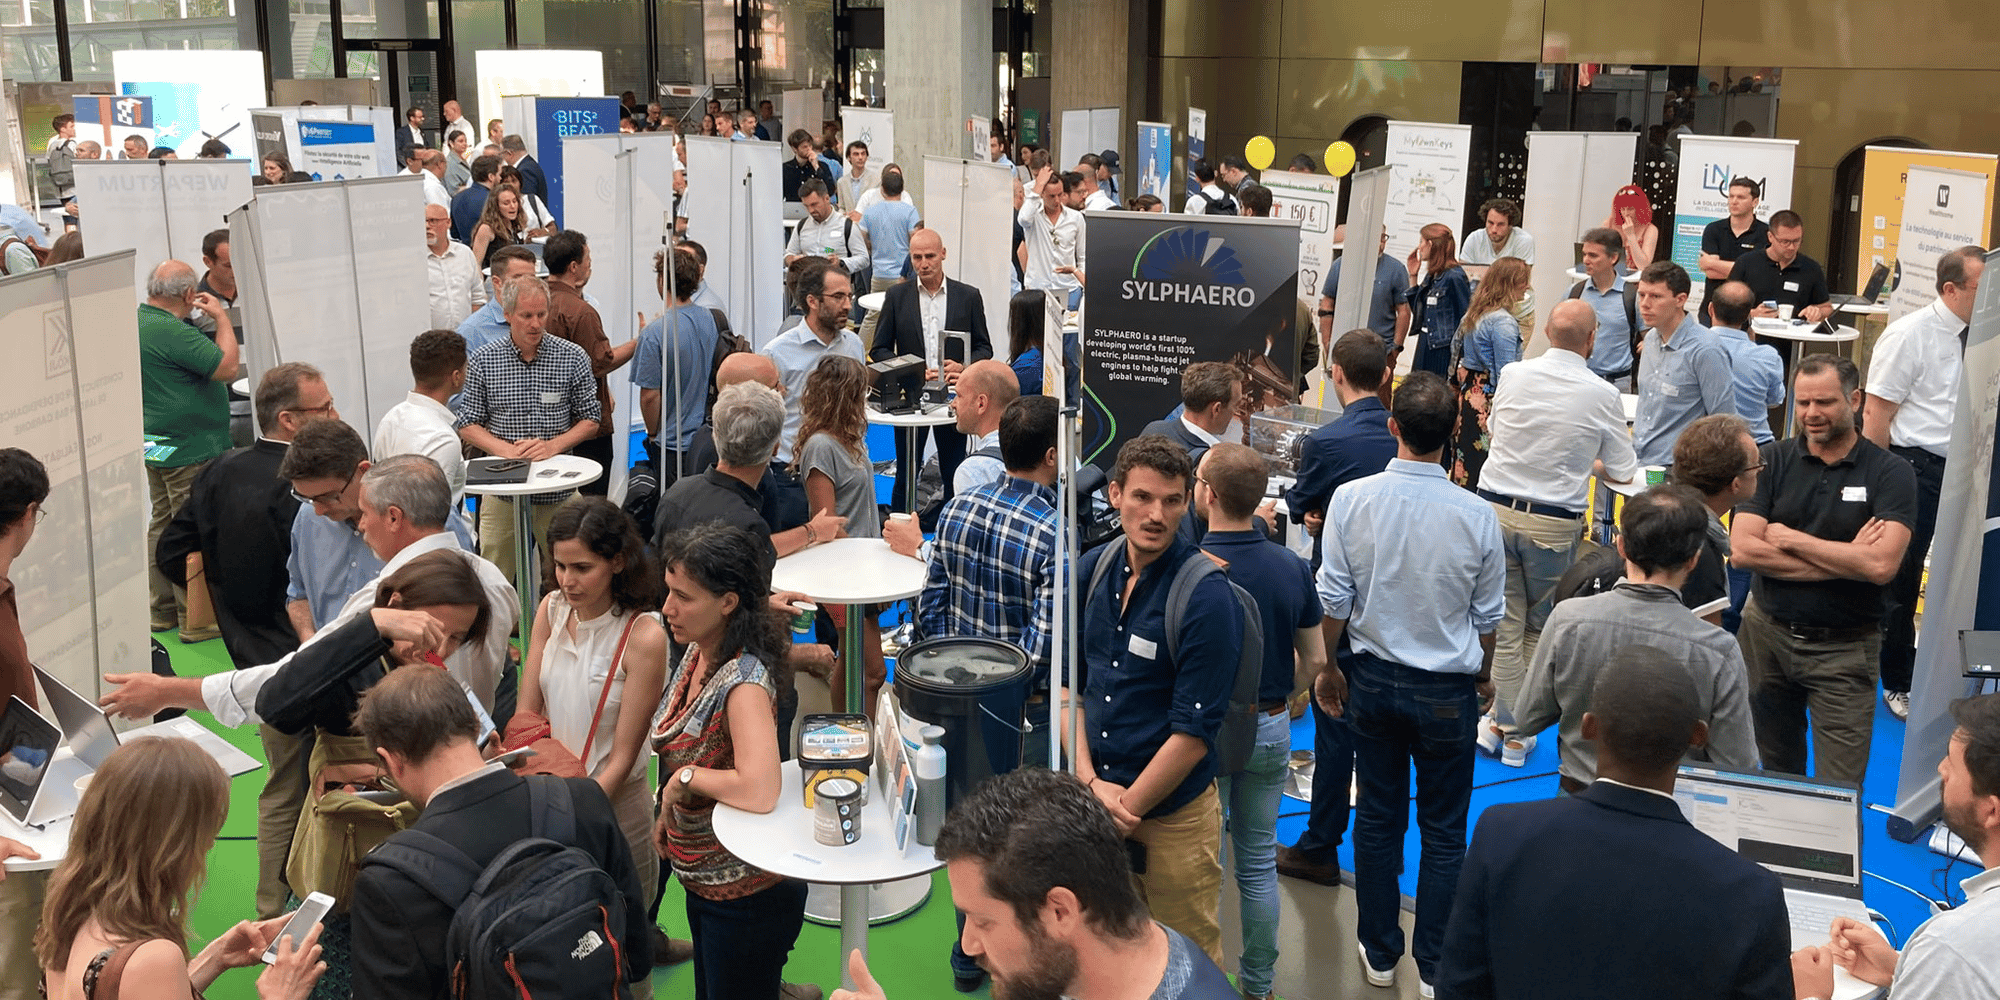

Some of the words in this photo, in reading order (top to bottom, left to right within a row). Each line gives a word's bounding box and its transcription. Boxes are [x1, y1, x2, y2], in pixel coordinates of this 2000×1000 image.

[558, 124, 598, 137] BEAT
[1702, 200, 1729, 208] SOLUTIO
[1905, 222, 1912, 232] La
[1913, 224, 1944, 239] technologie
[1944, 230, 1952, 239] au
[1952, 231, 1974, 244] service
[1917, 241, 1925, 251] du
[1121, 280, 1256, 308] SYLPHAERO
[1094, 328, 1142, 340] SYLPHAERO
[1142, 332, 1150, 340] is
[1158, 334, 1187, 344] startup
[1085, 338, 1127, 351] developing
[1128, 342, 1157, 352] world's
[1158, 343, 1175, 353] first
[1176, 345, 1195, 355] 100%
[1090, 350, 1121, 360] electric,
[1122, 352, 1178, 364] plasma-based
[1179, 356, 1190, 366] jet
[1100, 362, 1131, 371] engines
[1132, 363, 1141, 371] to
[1141, 363, 1159, 374] help
[1160, 365, 1178, 375] fight
[1108, 371, 1132, 381] global
[1134, 375, 1170, 385] warming.
